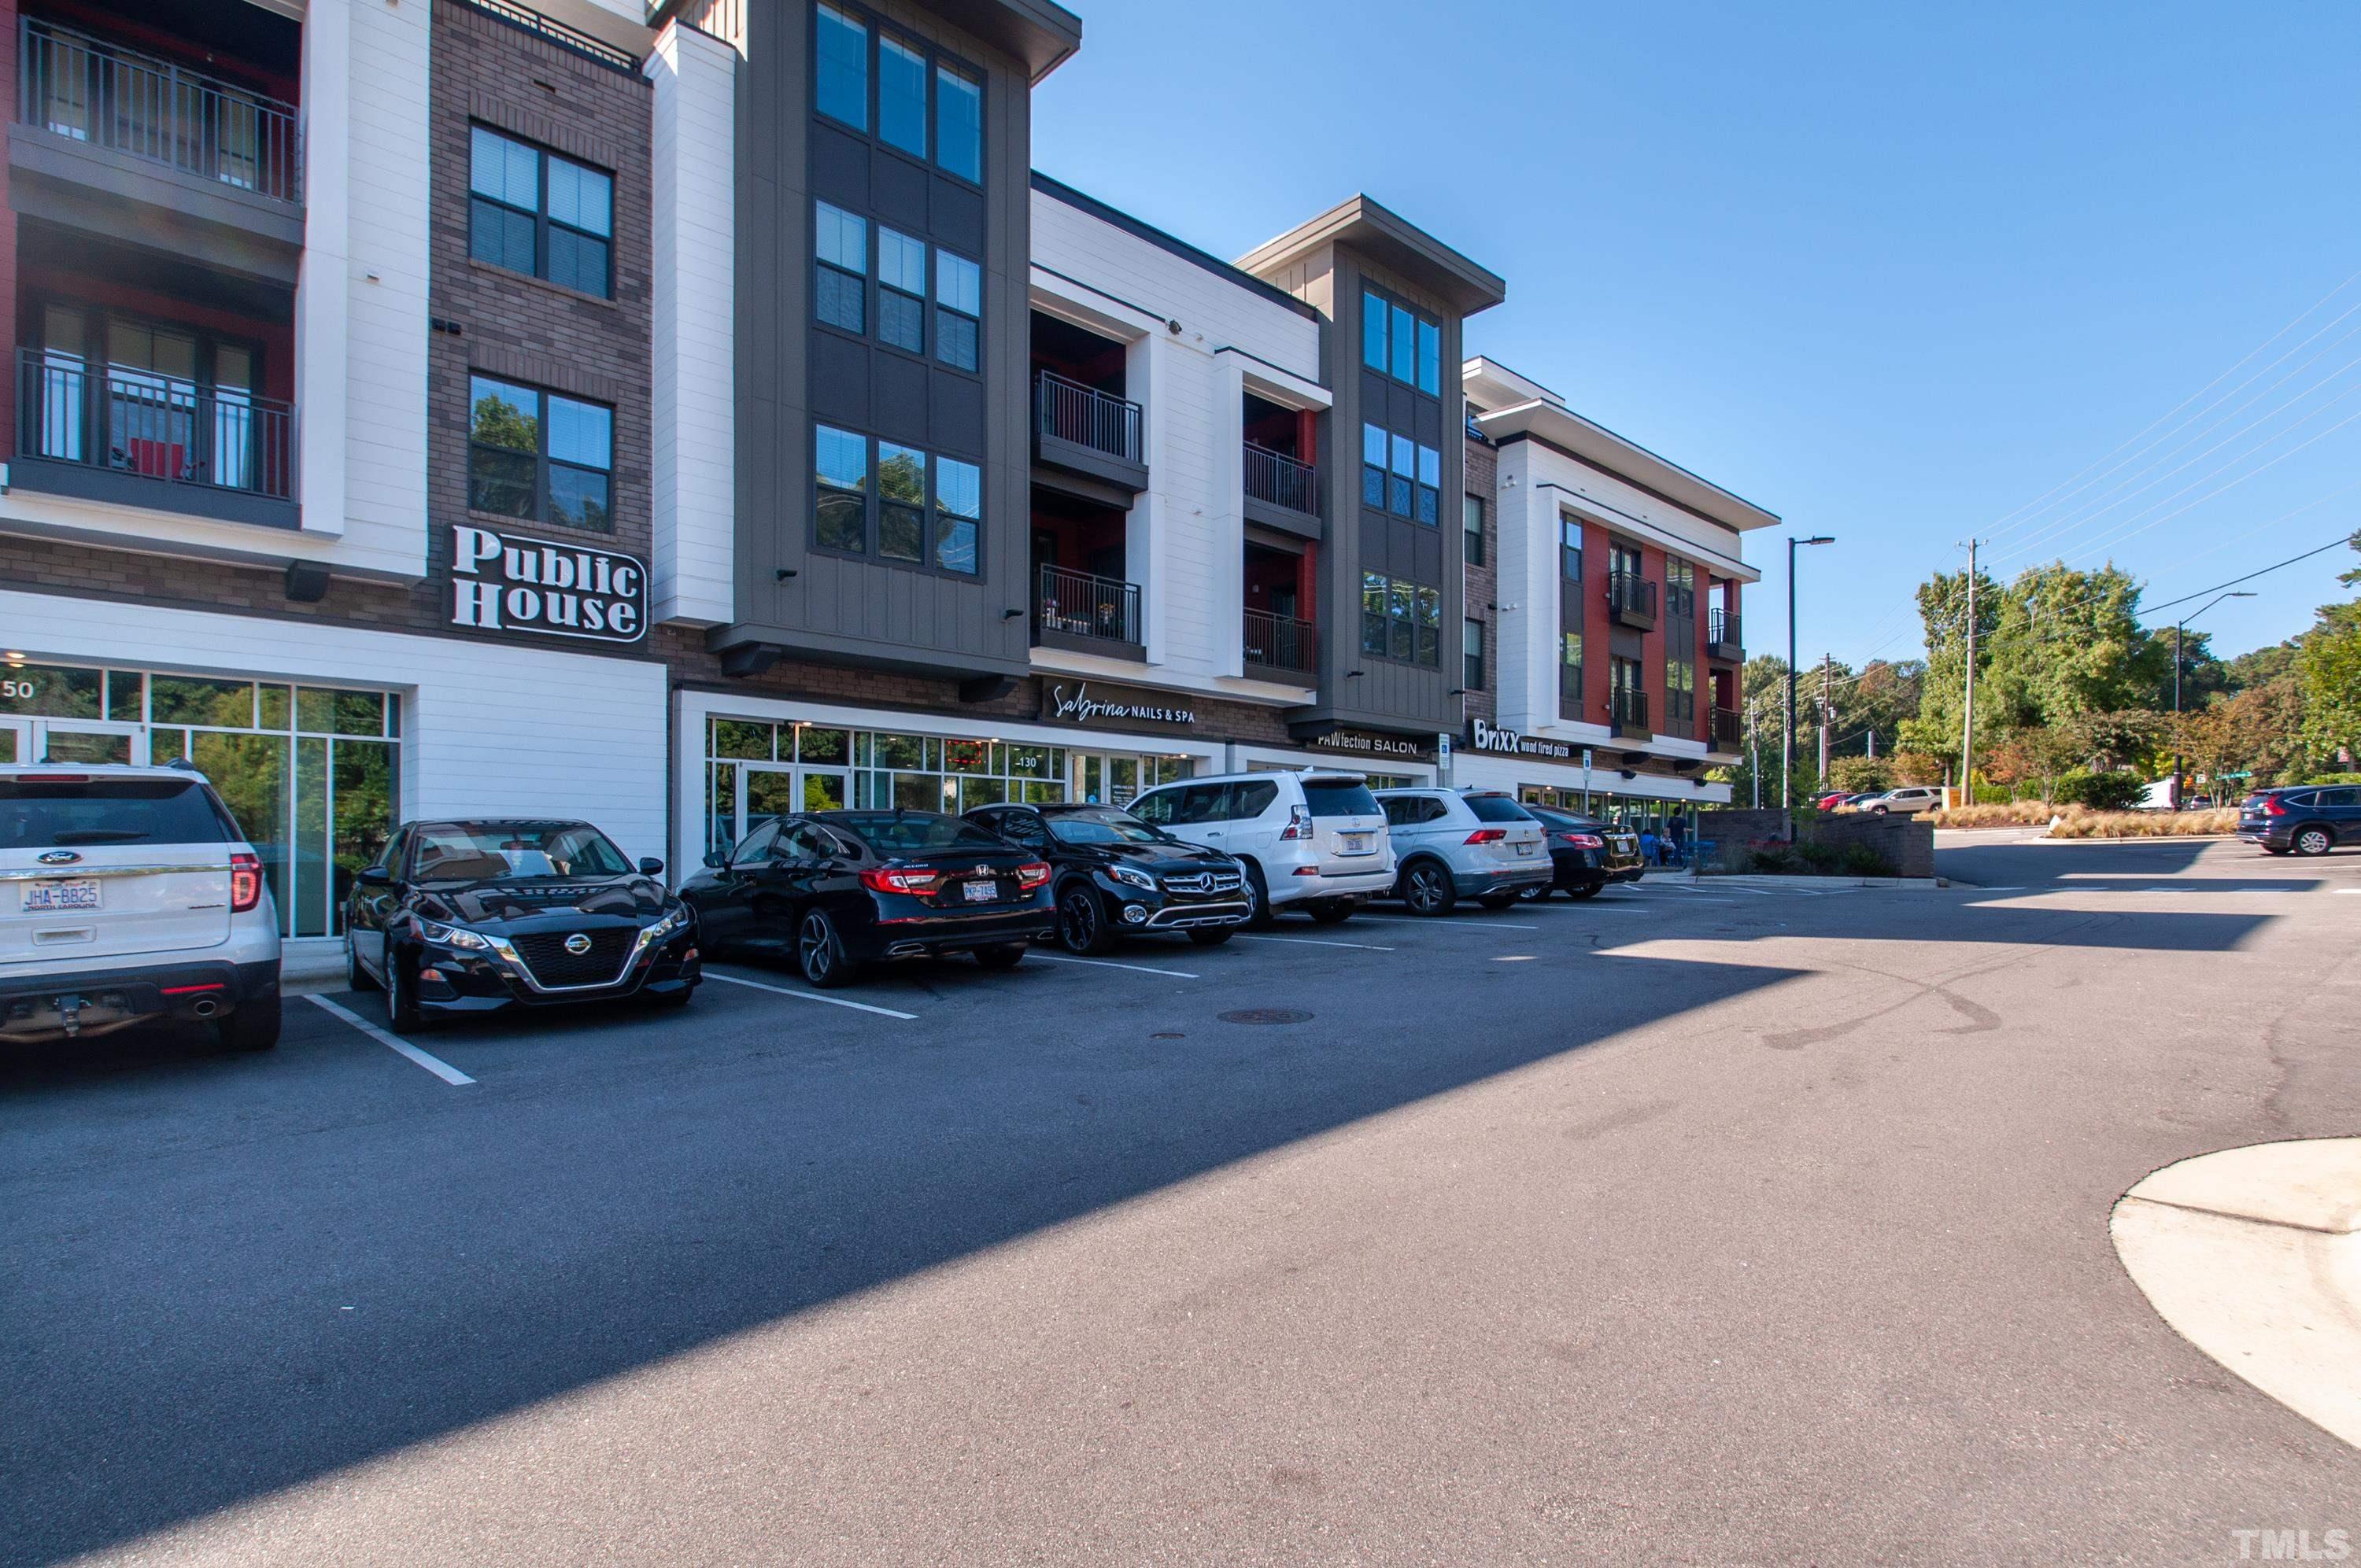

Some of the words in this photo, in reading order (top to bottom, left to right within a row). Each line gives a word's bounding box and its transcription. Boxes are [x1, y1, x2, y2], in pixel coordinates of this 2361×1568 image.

[453, 526, 637, 597] Public
[452, 578, 637, 633] House
[3, 681, 34, 699] 50
[1054, 682, 1129, 721] Sabrina
[1131, 707, 1162, 719] NAILS
[1165, 710, 1173, 721] &
[1176, 710, 1195, 723] SPA
[1374, 739, 1417, 754] SALON
[1473, 718, 1520, 753] Brixx
[1520, 741, 1537, 753] wood
[1538, 742, 1553, 756] fired
[1554, 745, 1568, 758] pizza
[1020, 757, 1036, 768] 130
[24, 887, 97, 905] JHA-8825
